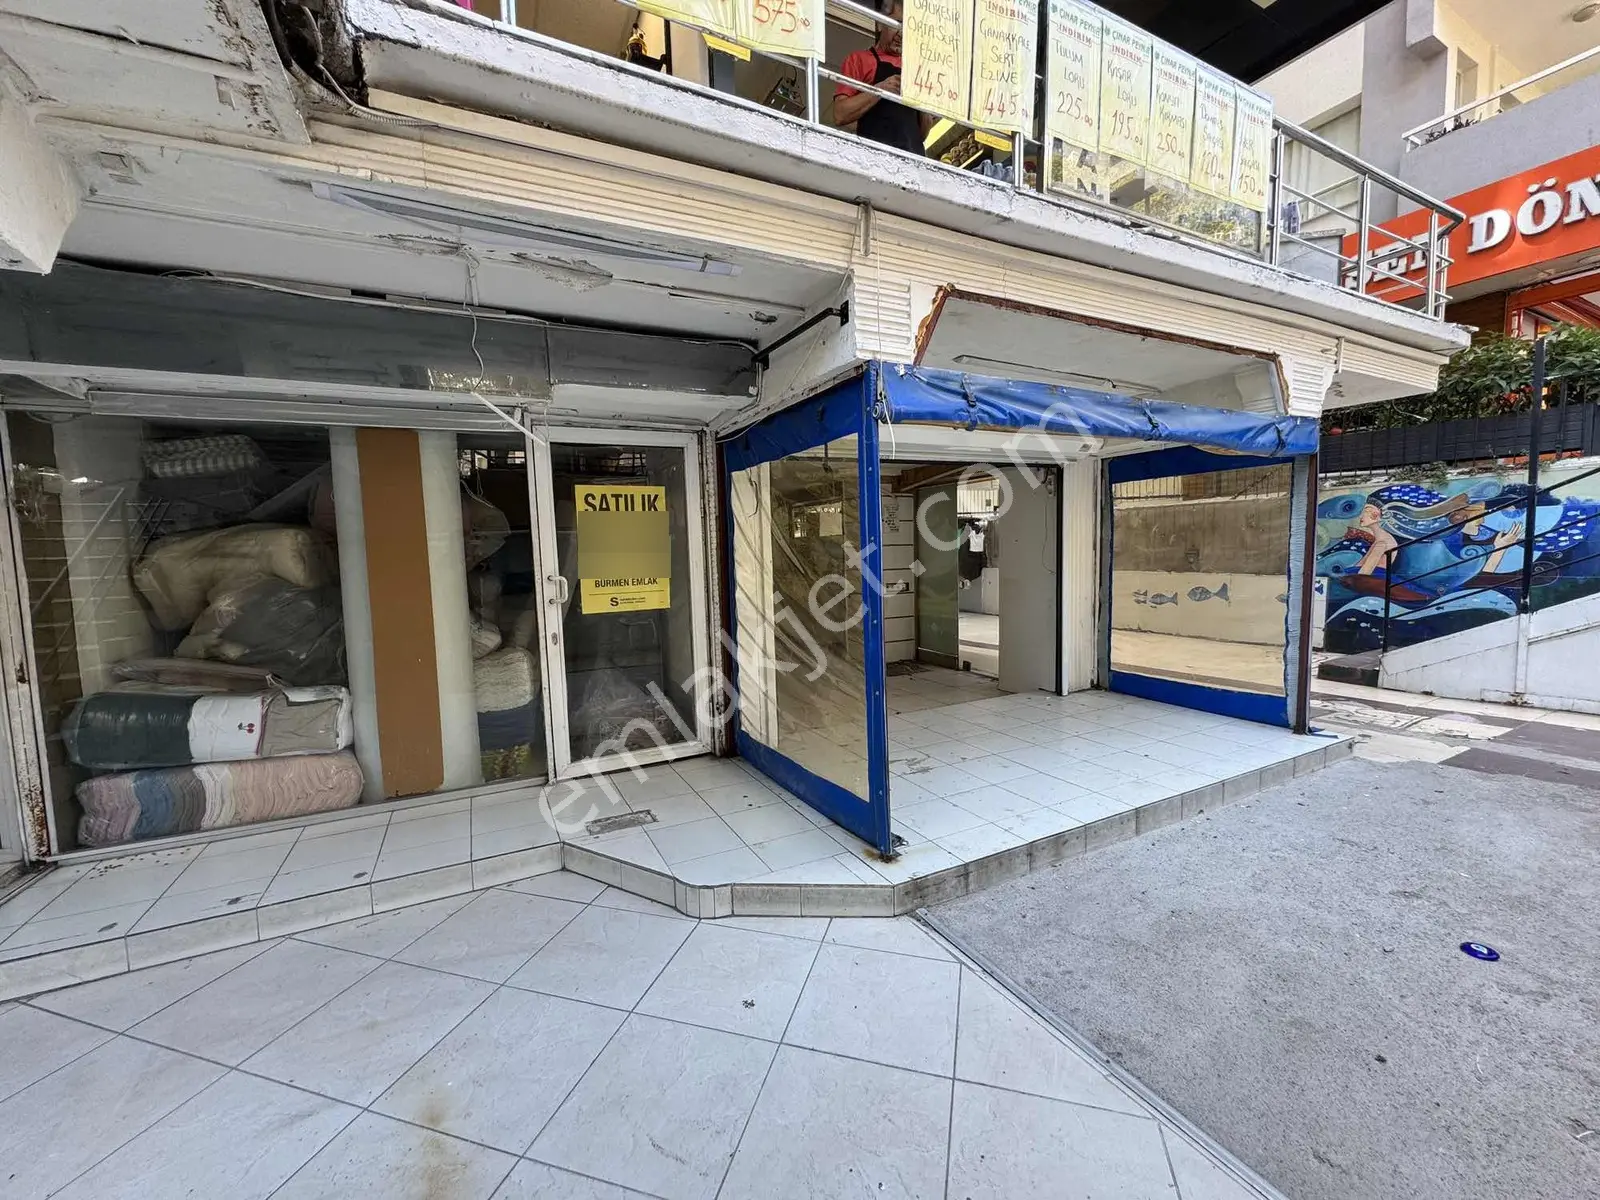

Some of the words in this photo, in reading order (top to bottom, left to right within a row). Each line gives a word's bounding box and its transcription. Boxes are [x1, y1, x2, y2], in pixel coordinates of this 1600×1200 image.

[991, 45, 1016, 68] SERT
[583, 493, 660, 511] SATILIK
[594, 578, 630, 588] BURMEN
[631, 577, 658, 587] EMLAK
